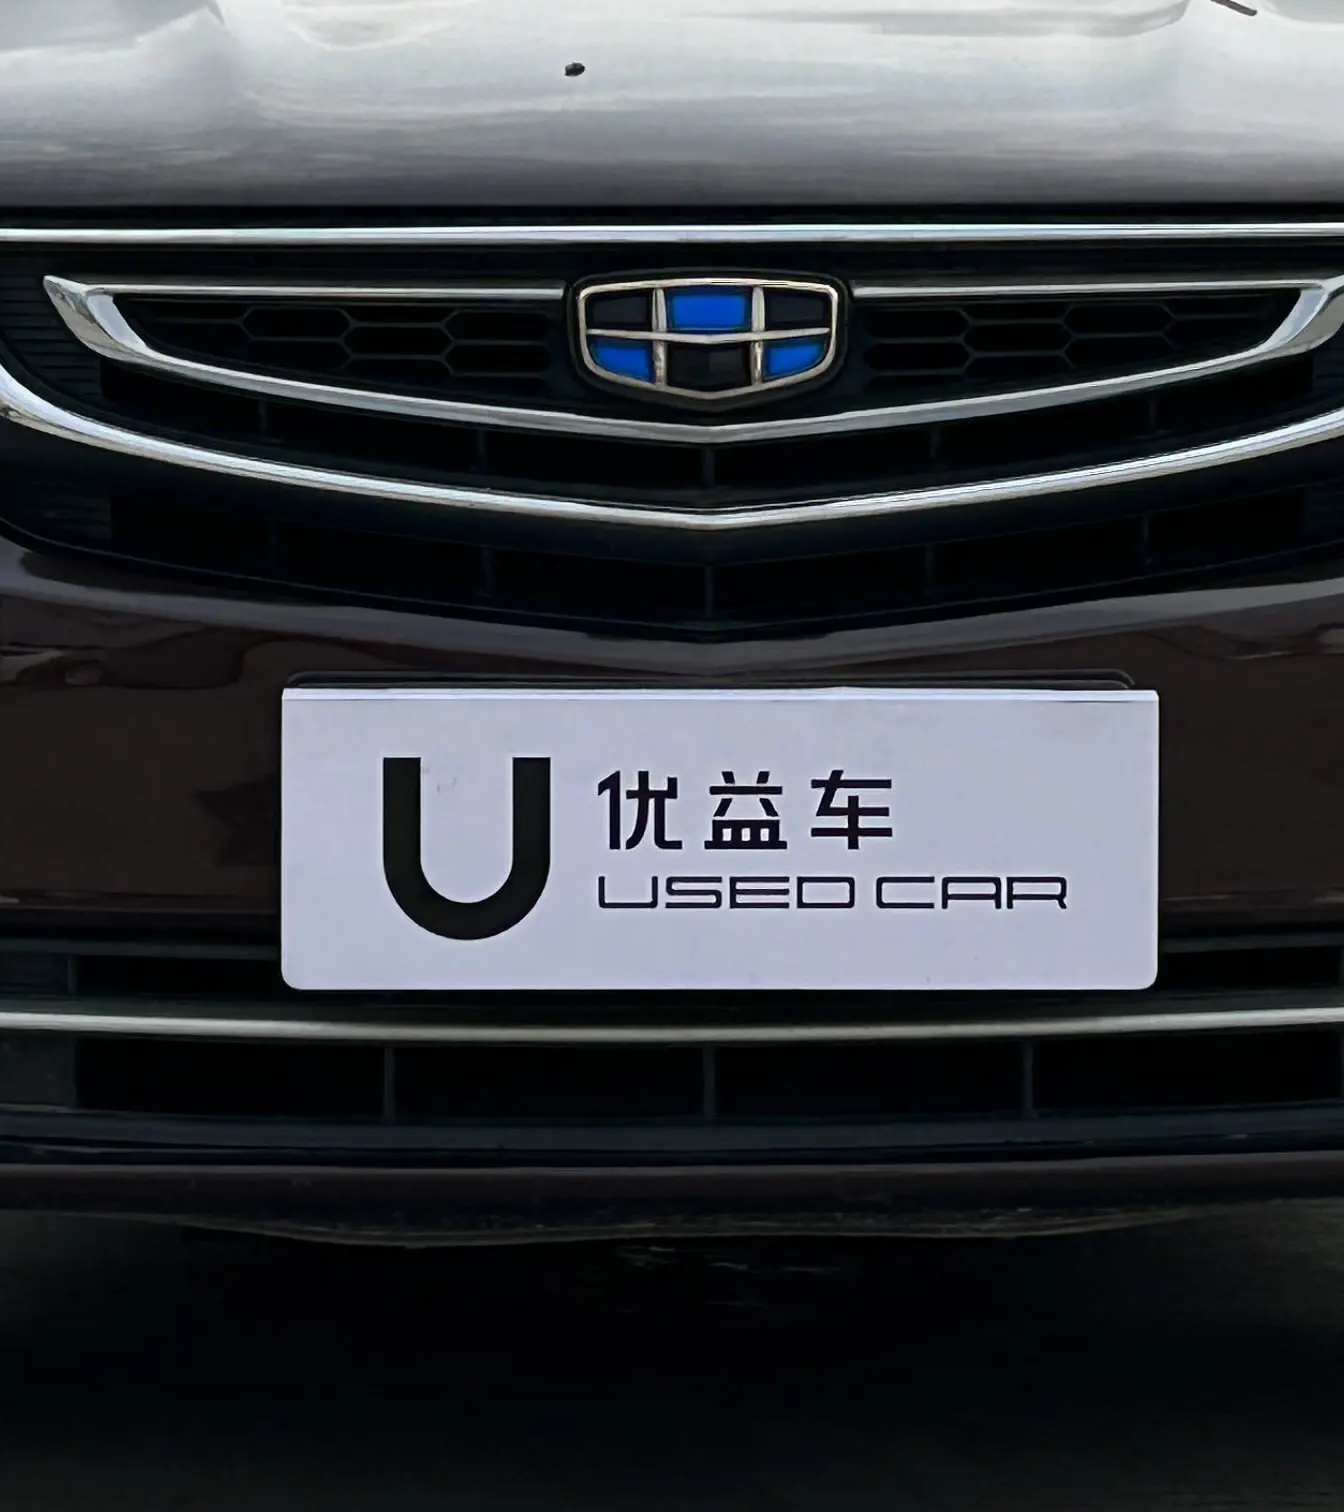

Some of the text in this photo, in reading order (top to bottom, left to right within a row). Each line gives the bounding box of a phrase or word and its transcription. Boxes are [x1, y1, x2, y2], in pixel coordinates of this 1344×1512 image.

[382, 756, 551, 941] U
[597, 769, 893, 850] 优益车
[598, 875, 1067, 910] USED CAR
